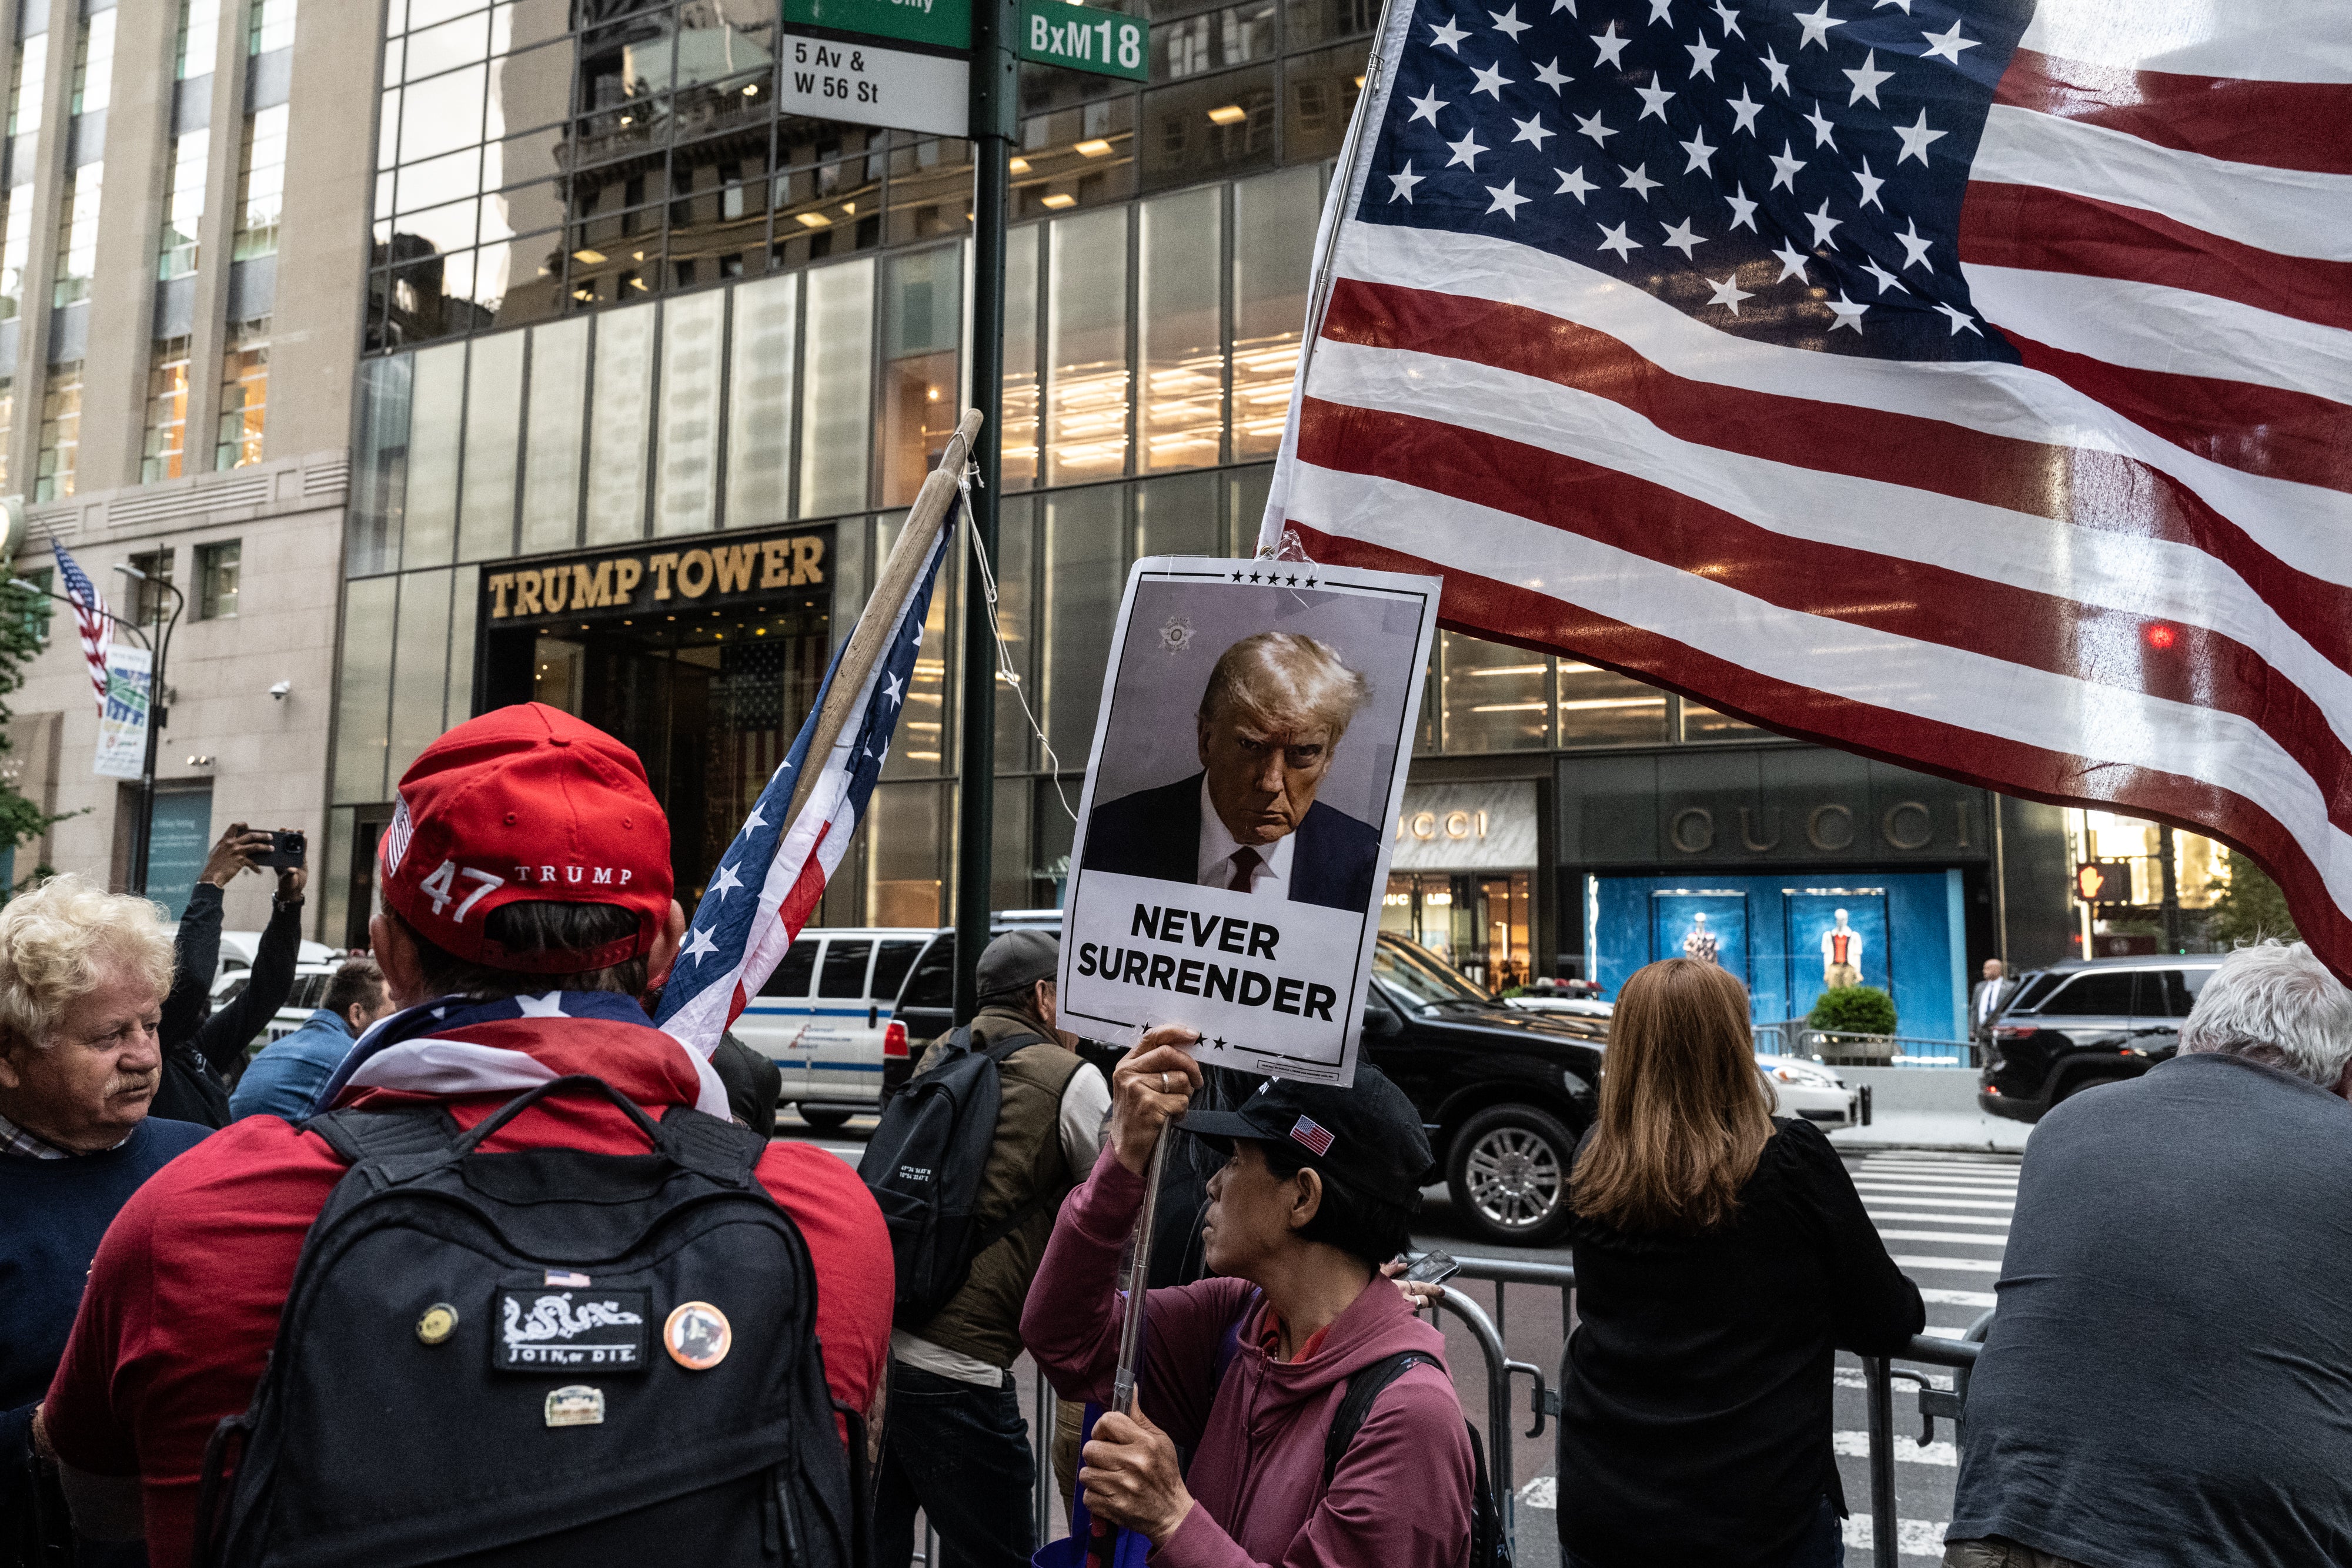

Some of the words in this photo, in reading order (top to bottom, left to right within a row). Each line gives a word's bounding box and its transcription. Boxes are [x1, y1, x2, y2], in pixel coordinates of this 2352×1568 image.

[796, 42, 807, 63] 5
[816, 45, 841, 68] Av
[850, 51, 864, 72] &
[1030, 15, 1141, 69] BxM18
[794, 72, 815, 93] W
[823, 78, 849, 99] 56
[857, 82, 878, 104] St
[488, 557, 643, 618] TRUMP
[649, 536, 824, 600] TOWER
[1671, 800, 1970, 853] GUCCI
[419, 859, 506, 923] 47
[514, 865, 633, 886] TRUMP
[1131, 903, 1280, 961] NEVER
[1077, 942, 1337, 1022] SURRENDER
